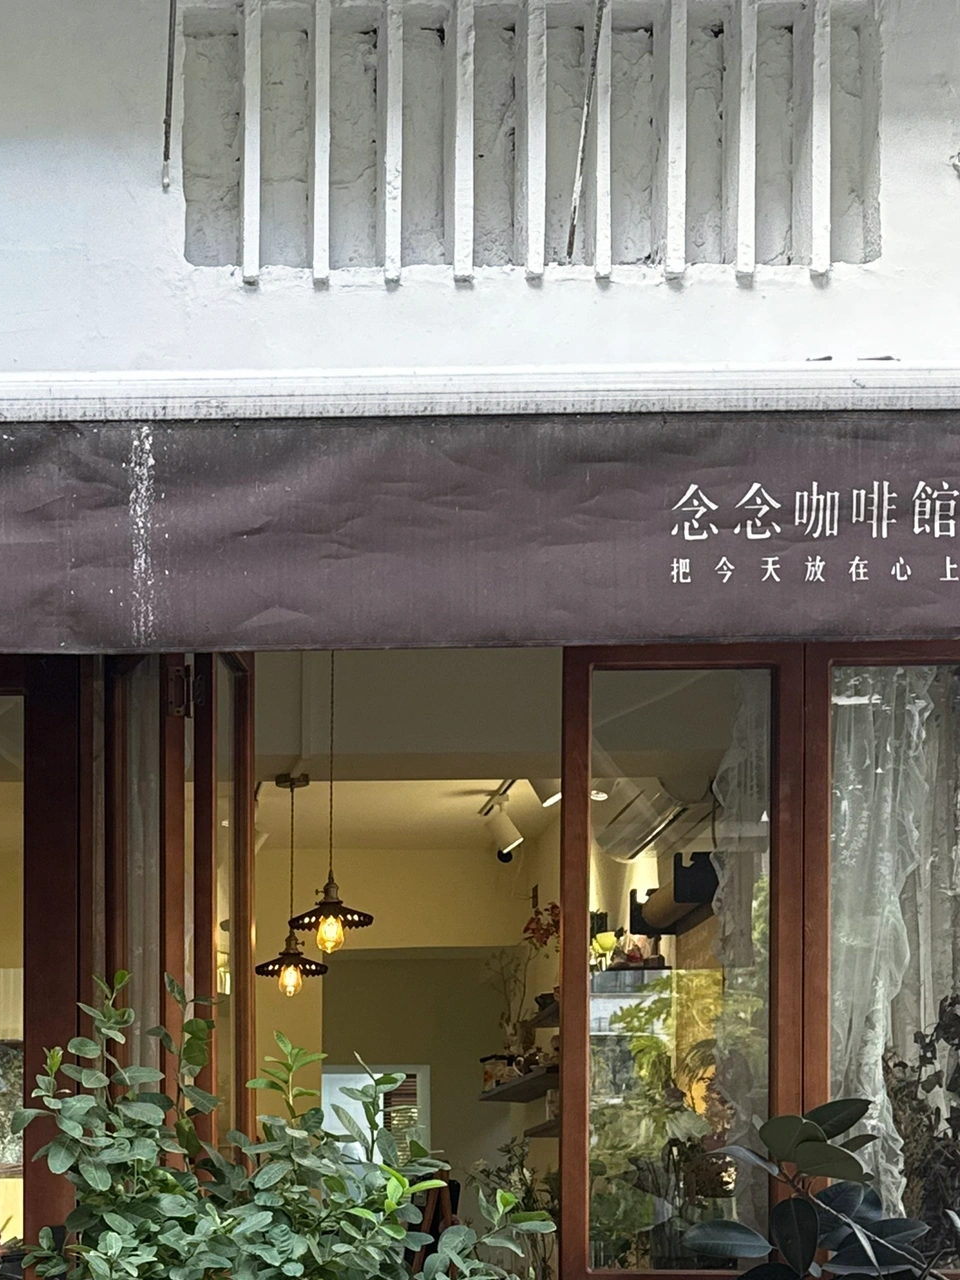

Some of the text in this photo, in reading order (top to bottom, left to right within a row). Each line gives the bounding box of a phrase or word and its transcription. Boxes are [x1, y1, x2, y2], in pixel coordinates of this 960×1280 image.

[671, 481, 959, 541] 念念咖啡館
[670, 556, 959, 583] 把今天放在心上
